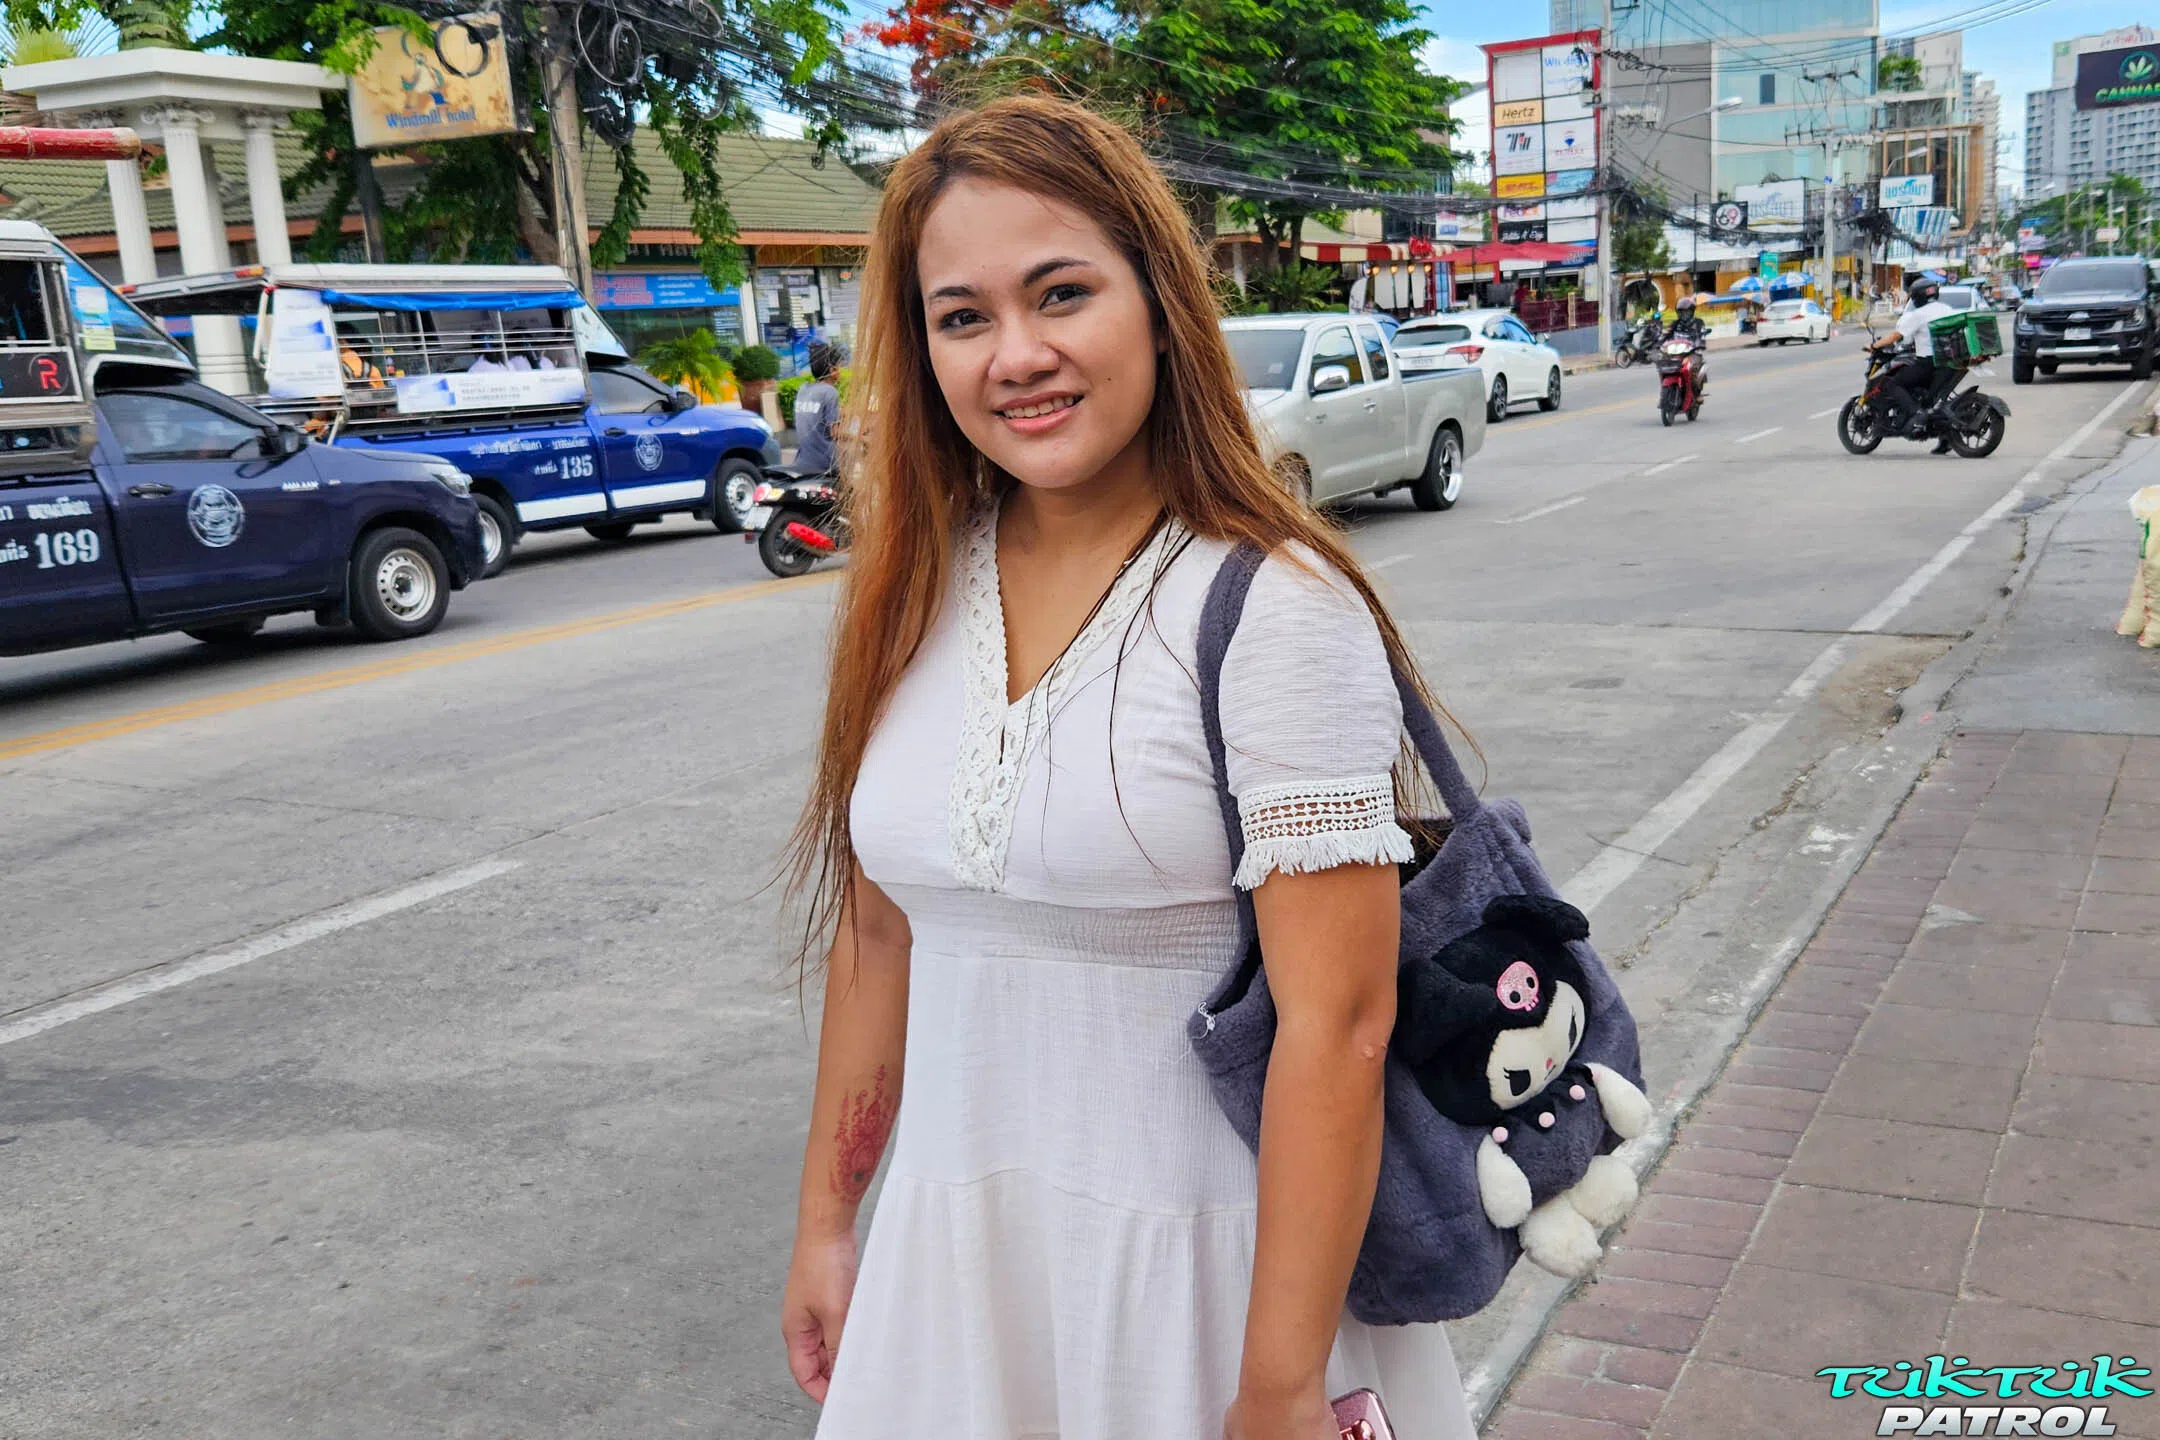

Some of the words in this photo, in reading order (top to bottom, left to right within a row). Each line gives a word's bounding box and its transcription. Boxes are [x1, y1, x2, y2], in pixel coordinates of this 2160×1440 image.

[1502, 106, 1536, 120] Hertz
[561, 454, 594, 480] 135
[34, 528, 100, 569] 169
